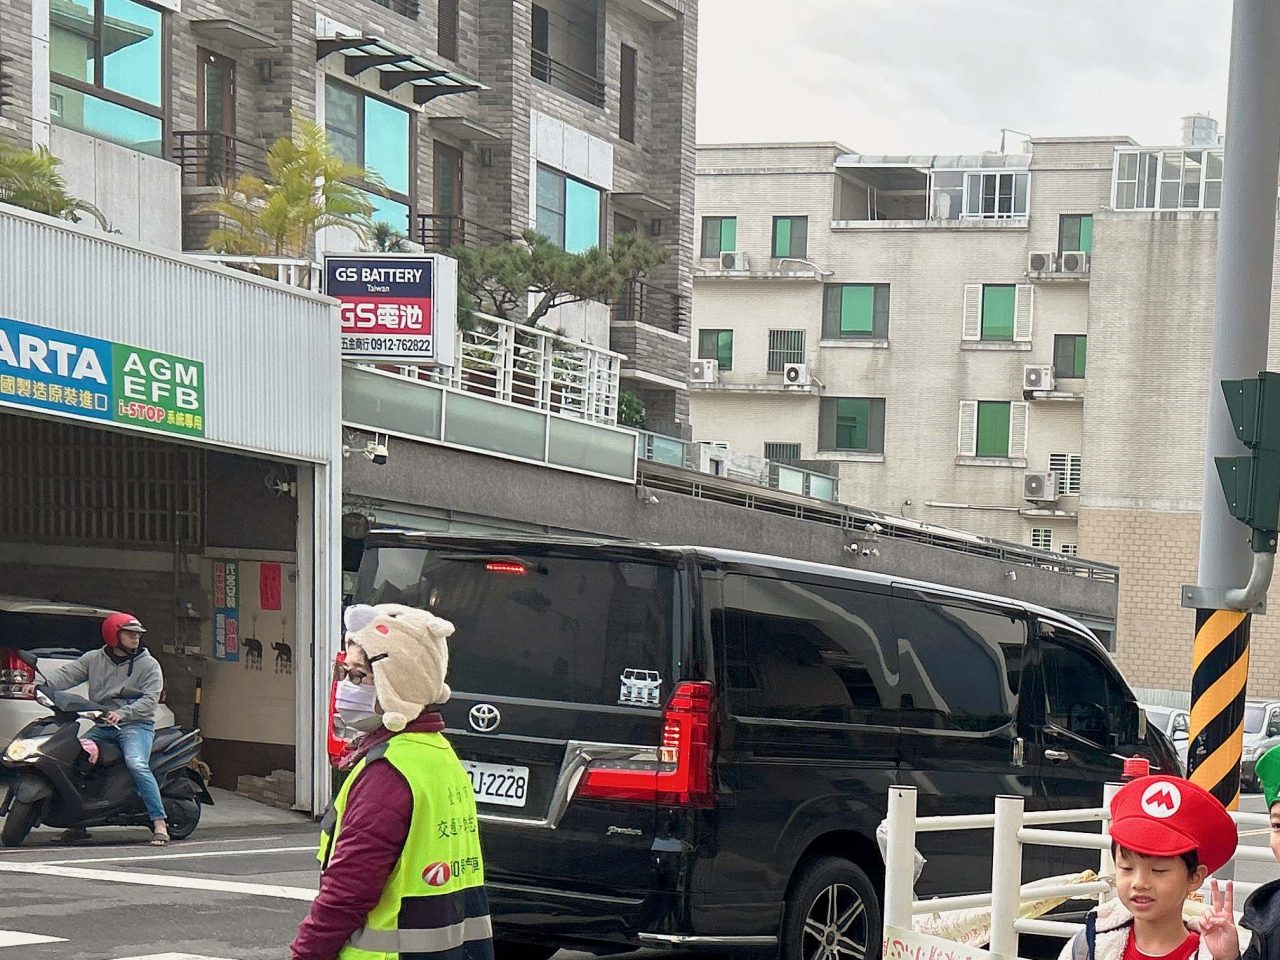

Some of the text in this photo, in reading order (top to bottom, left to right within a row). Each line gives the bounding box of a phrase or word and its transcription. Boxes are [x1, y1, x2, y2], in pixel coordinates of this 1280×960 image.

[335, 267, 422, 283] GS BATTERY
[367, 284, 390, 292] Taiwan
[341, 302, 423, 329] GS電池
[123, 352, 198, 387] AGM
[124, 375, 199, 410] EFB
[118, 399, 165, 423] i-STOP
[1145, 788, 1175, 811] M
